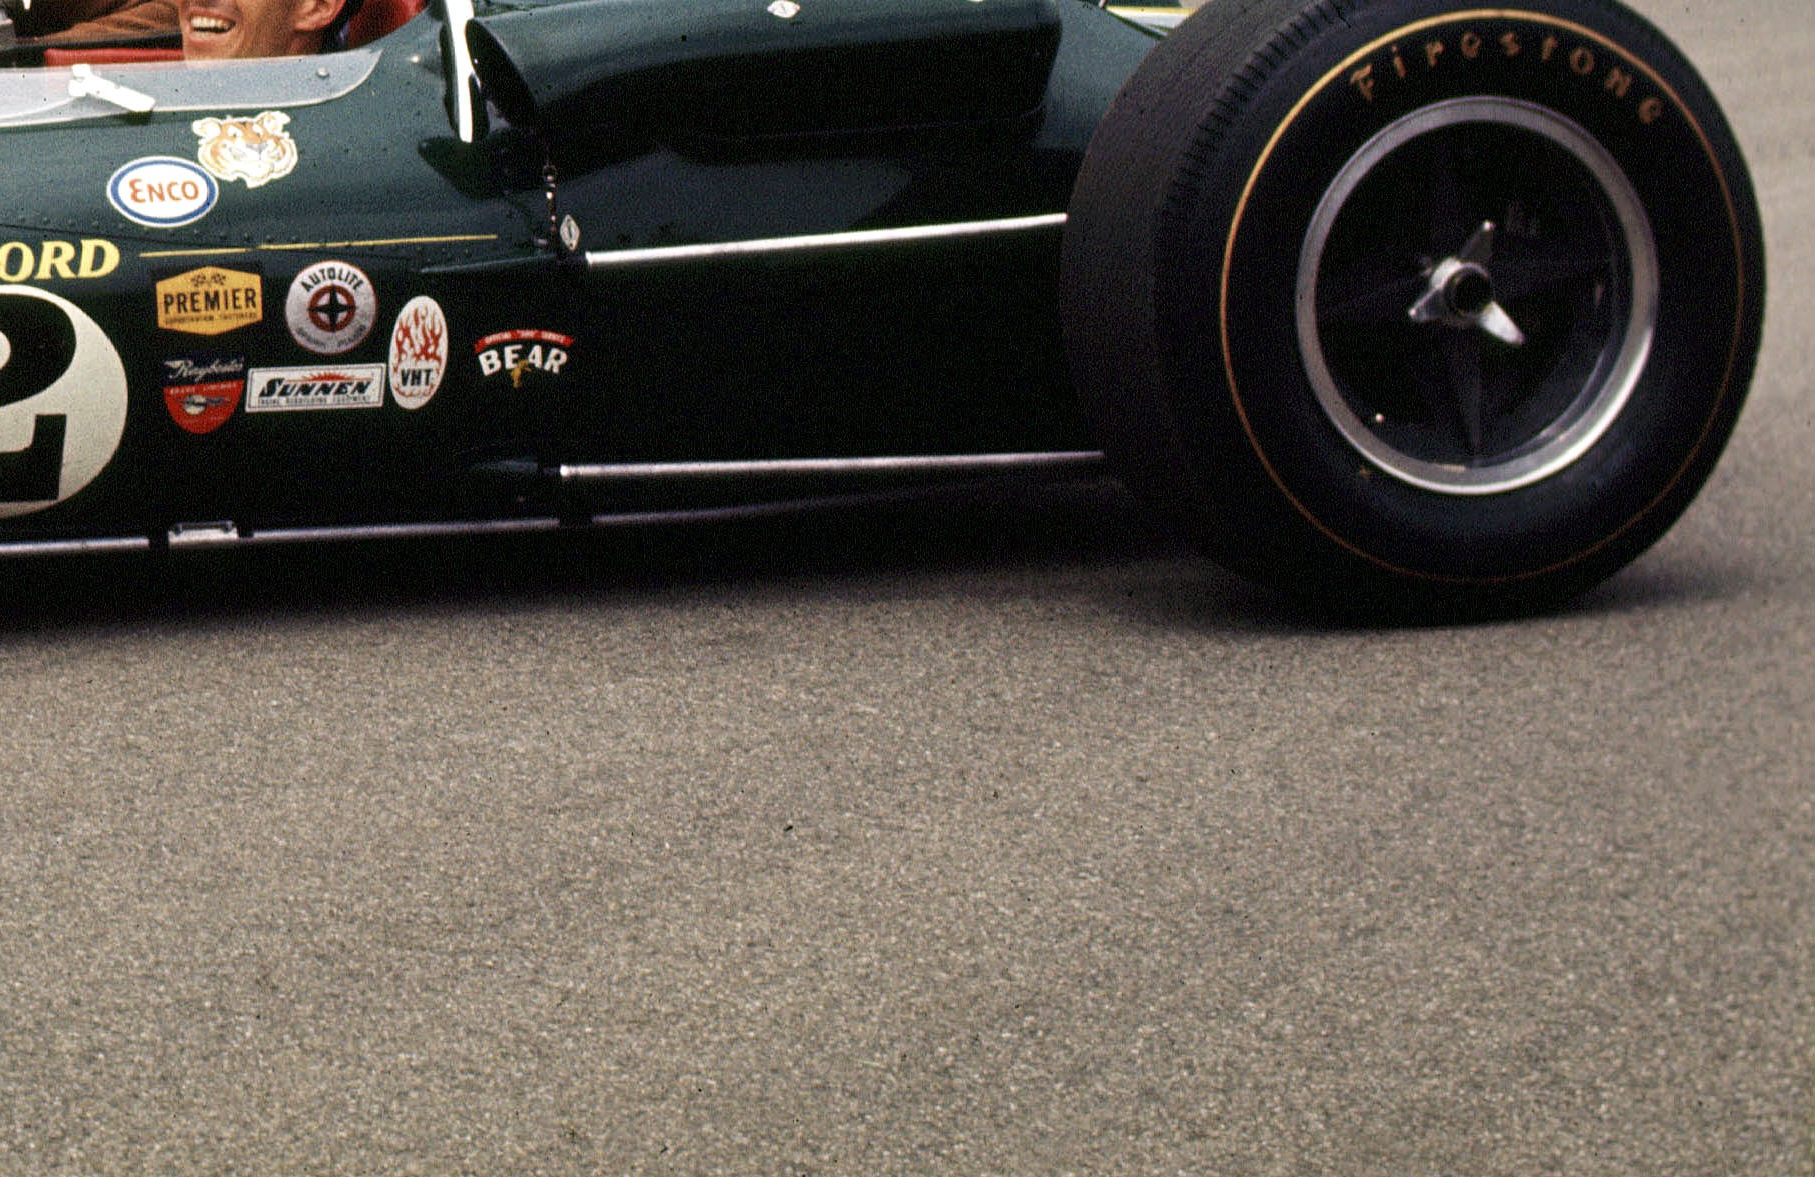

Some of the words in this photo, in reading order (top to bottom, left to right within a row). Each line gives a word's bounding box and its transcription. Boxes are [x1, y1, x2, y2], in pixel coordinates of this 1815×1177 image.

[1350, 31, 1663, 125] Firestone
[301, 267, 364, 292] AUTOLITE
[164, 288, 257, 314] PREMIER
[478, 344, 567, 376] BEAR
[259, 378, 373, 398] SUNNEN
[401, 369, 433, 387] VHT
